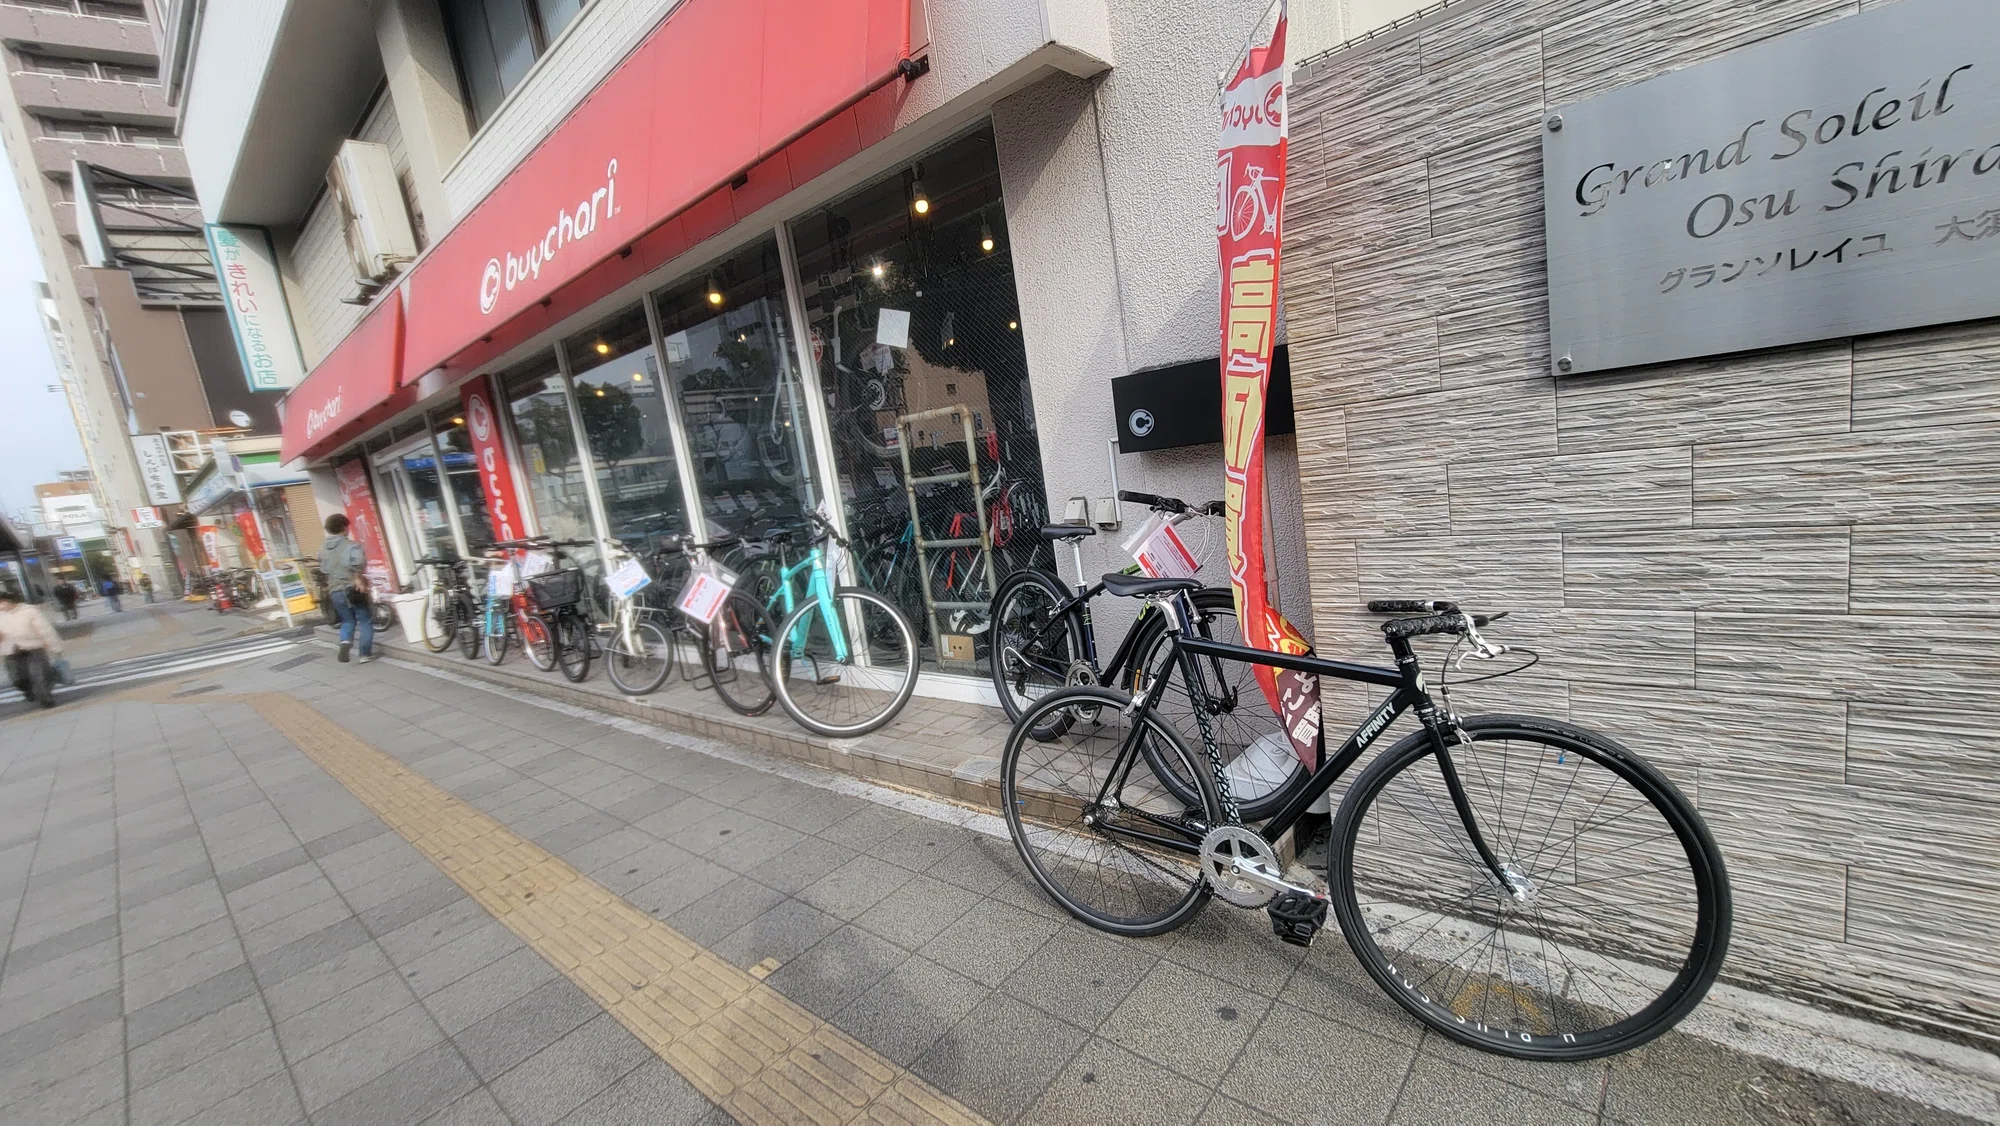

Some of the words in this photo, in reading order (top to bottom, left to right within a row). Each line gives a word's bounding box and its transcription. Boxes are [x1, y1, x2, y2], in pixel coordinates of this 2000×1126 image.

[1575, 119, 1766, 217] Grand
[1770, 63, 1974, 161] Soleil
[505, 158, 617, 291] buychari
[1686, 189, 1800, 239] Osu
[1820, 143, 2000, 212] Shira
[1659, 233, 1894, 294] グランソレイユ
[1356, 702, 1396, 749] AFFINITY
